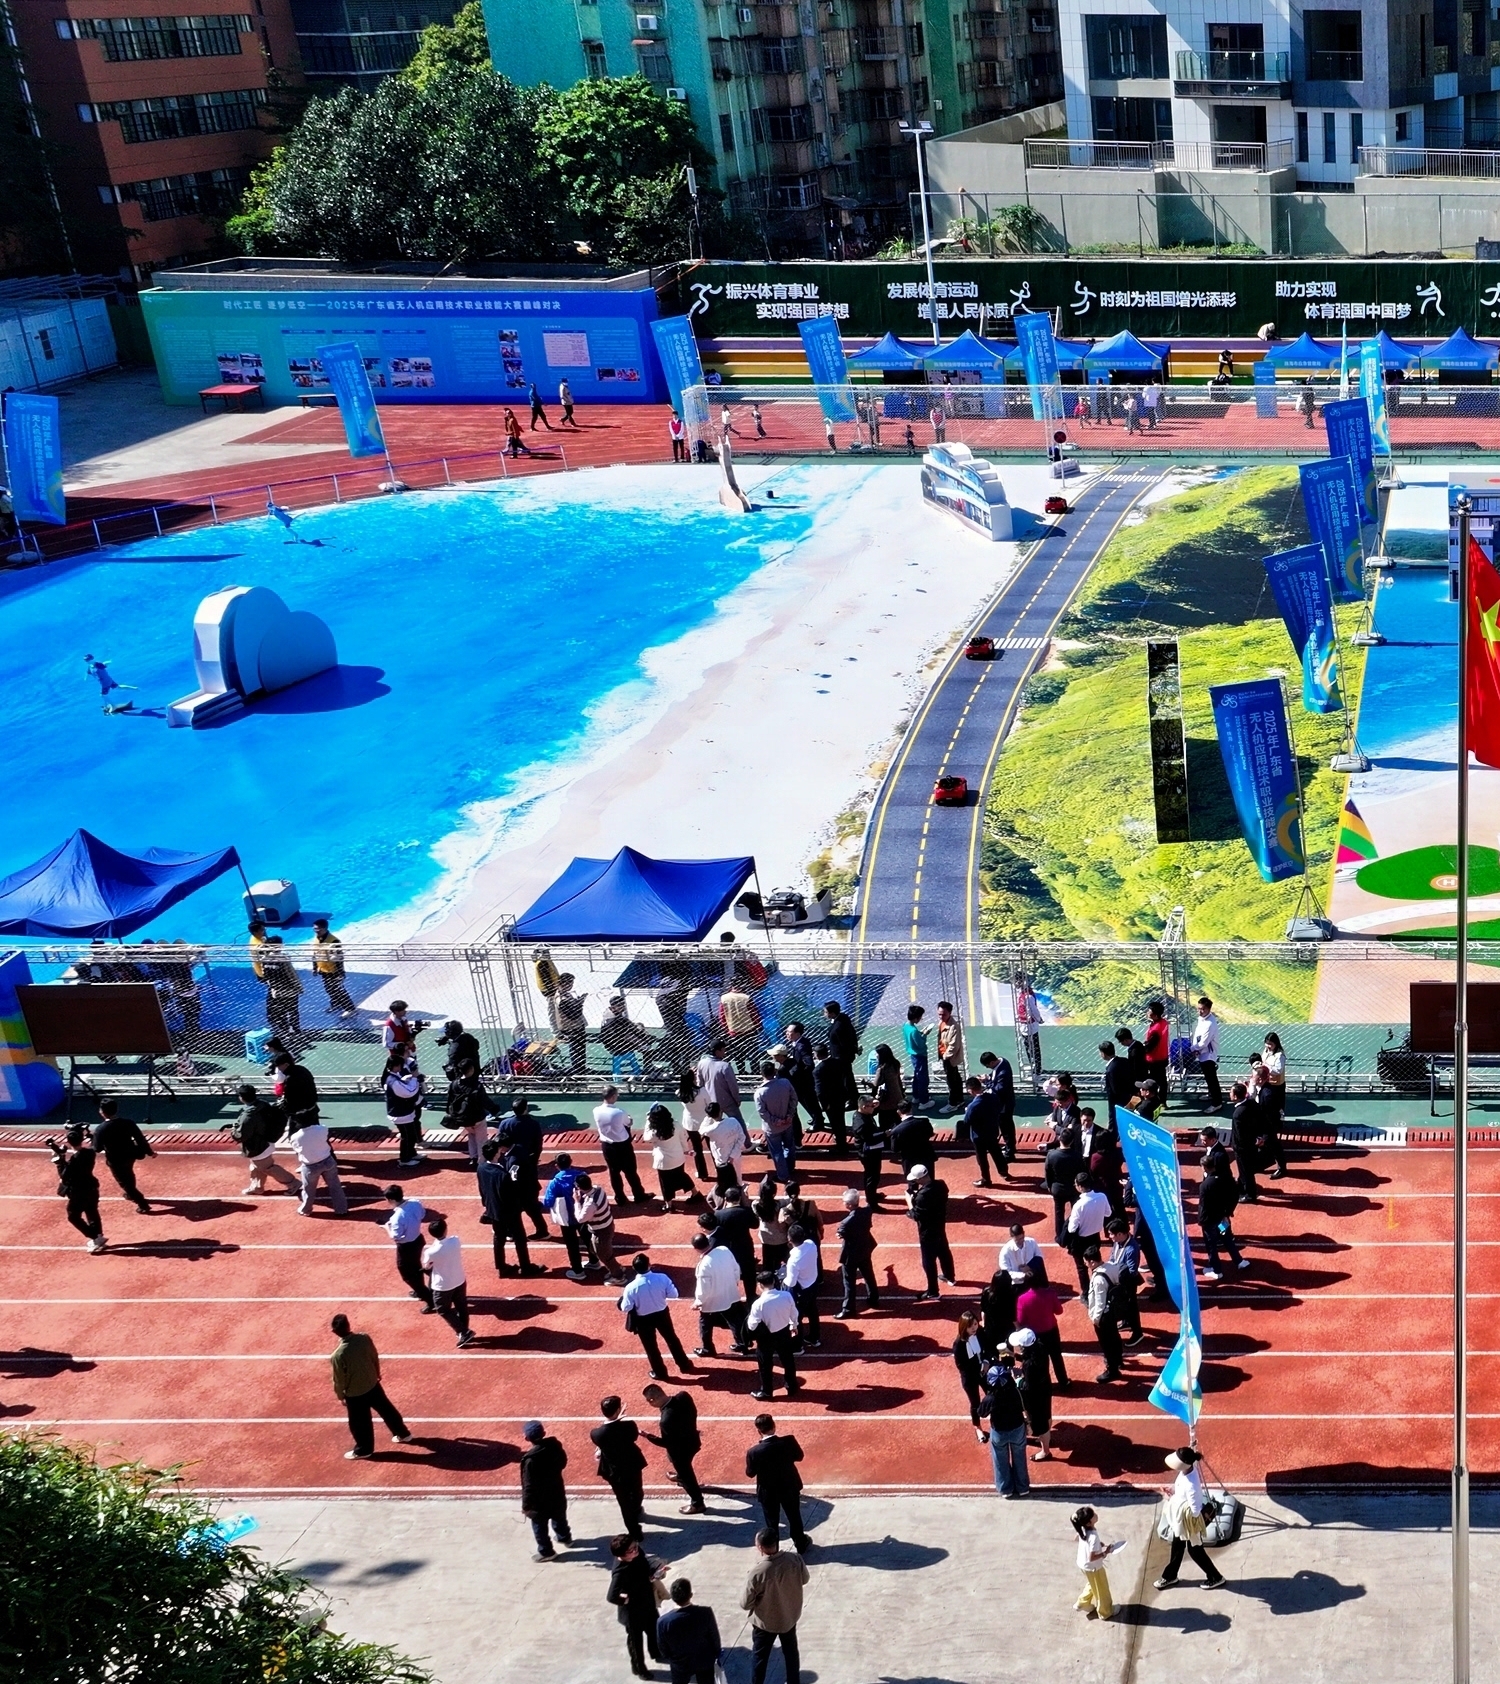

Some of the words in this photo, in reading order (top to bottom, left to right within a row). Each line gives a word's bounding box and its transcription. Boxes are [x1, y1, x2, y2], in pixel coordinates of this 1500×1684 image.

[725, 282, 820, 300] 振兴体育事业
[887, 281, 979, 300] 发展体育运动
[1099, 290, 1236, 309] 时刻为祖国增光添彩
[1275, 280, 1336, 298] 助力实现
[223, 300, 263, 311] 时代工匠
[756, 303, 850, 320] 实现强国梦想
[917, 302, 1009, 320] 增强人民体质
[1304, 302, 1412, 320] 体育强国中国梦
[1355, 416, 1367, 459] 2025年广东省
[1336, 478, 1350, 528] 2025年广东省
[1326, 480, 1347, 579] 无人机应用技术职业技能大赛
[1308, 570, 1325, 627] 2025年广东省
[1236, 726, 1244, 755] Guangdong
[1263, 710, 1283, 777] 2025年广东省
[1249, 712, 1279, 849] 无人机应用技术职业技能大赛
[1153, 1174, 1170, 1213] Guangdong
[1166, 1213, 1176, 1233] China
